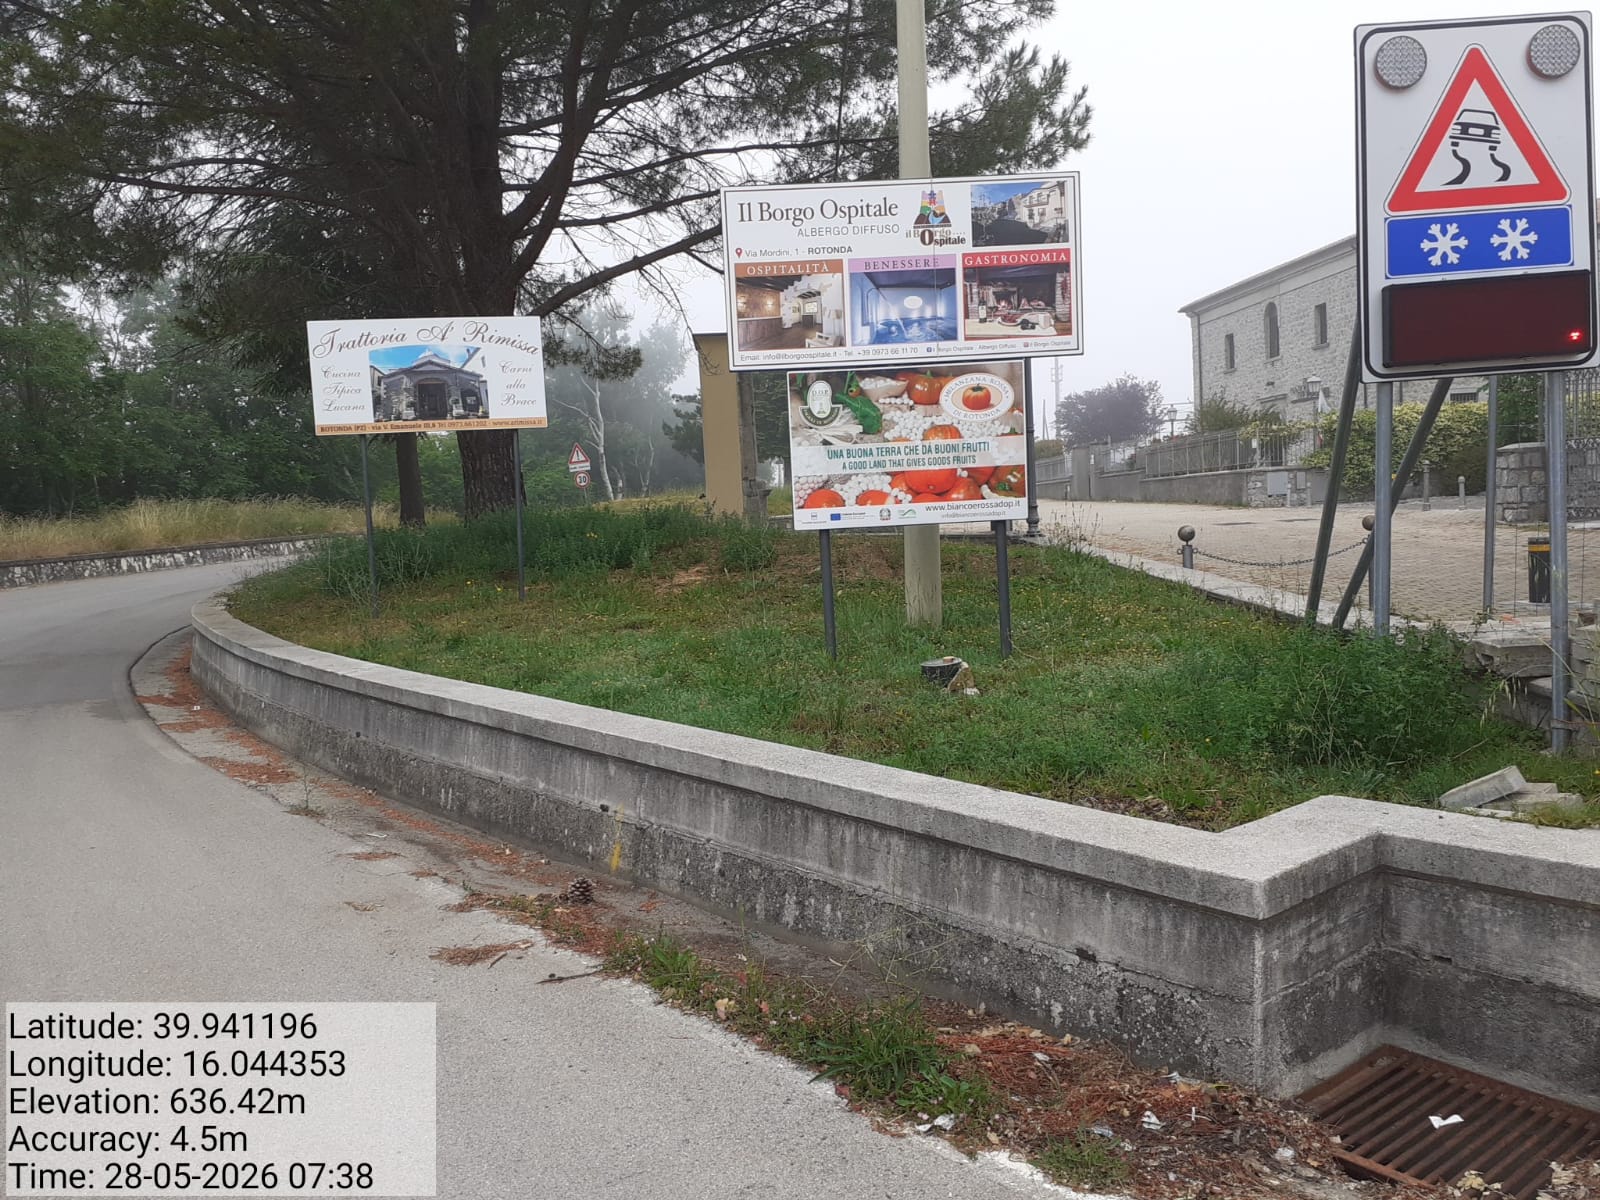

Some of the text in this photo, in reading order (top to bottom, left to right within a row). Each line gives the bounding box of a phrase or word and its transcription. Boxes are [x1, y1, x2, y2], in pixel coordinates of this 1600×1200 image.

[737, 196, 899, 228] Il Borgo Ospitale
[797, 223, 900, 238] ALBERGO DIFFUSO
[745, 249, 758, 258] Via
[759, 248, 794, 258] Mordini,
[795, 247, 800, 256] 1
[807, 245, 853, 255] ROTONDA
[864, 256, 940, 271] BENESSERE
[964, 252, 1068, 266] GASTRONOMIA
[746, 261, 830, 276] OSPITALITÀ
[312, 327, 408, 359] Trattoria
[462, 320, 539, 355] Rimissa
[321, 365, 361, 379] Cucina
[499, 360, 533, 374] Carni
[323, 382, 362, 396] Tipica
[505, 377, 526, 390] alla
[321, 398, 366, 412] Lucana
[500, 392, 537, 407] Brace
[320, 425, 353, 433] ROTONDA
[827, 448, 845, 460] UNA
[846, 447, 874, 459] BUONA
[876, 445, 901, 457] TERRA
[903, 444, 920, 456] CHE
[934, 442, 960, 455] BUONI
[961, 441, 990, 453] FRUTTI
[842, 454, 977, 471] A GOOD LAND THAT GIVES GOODS FRUITS
[925, 499, 1021, 512] www.biancoerossadop.it
